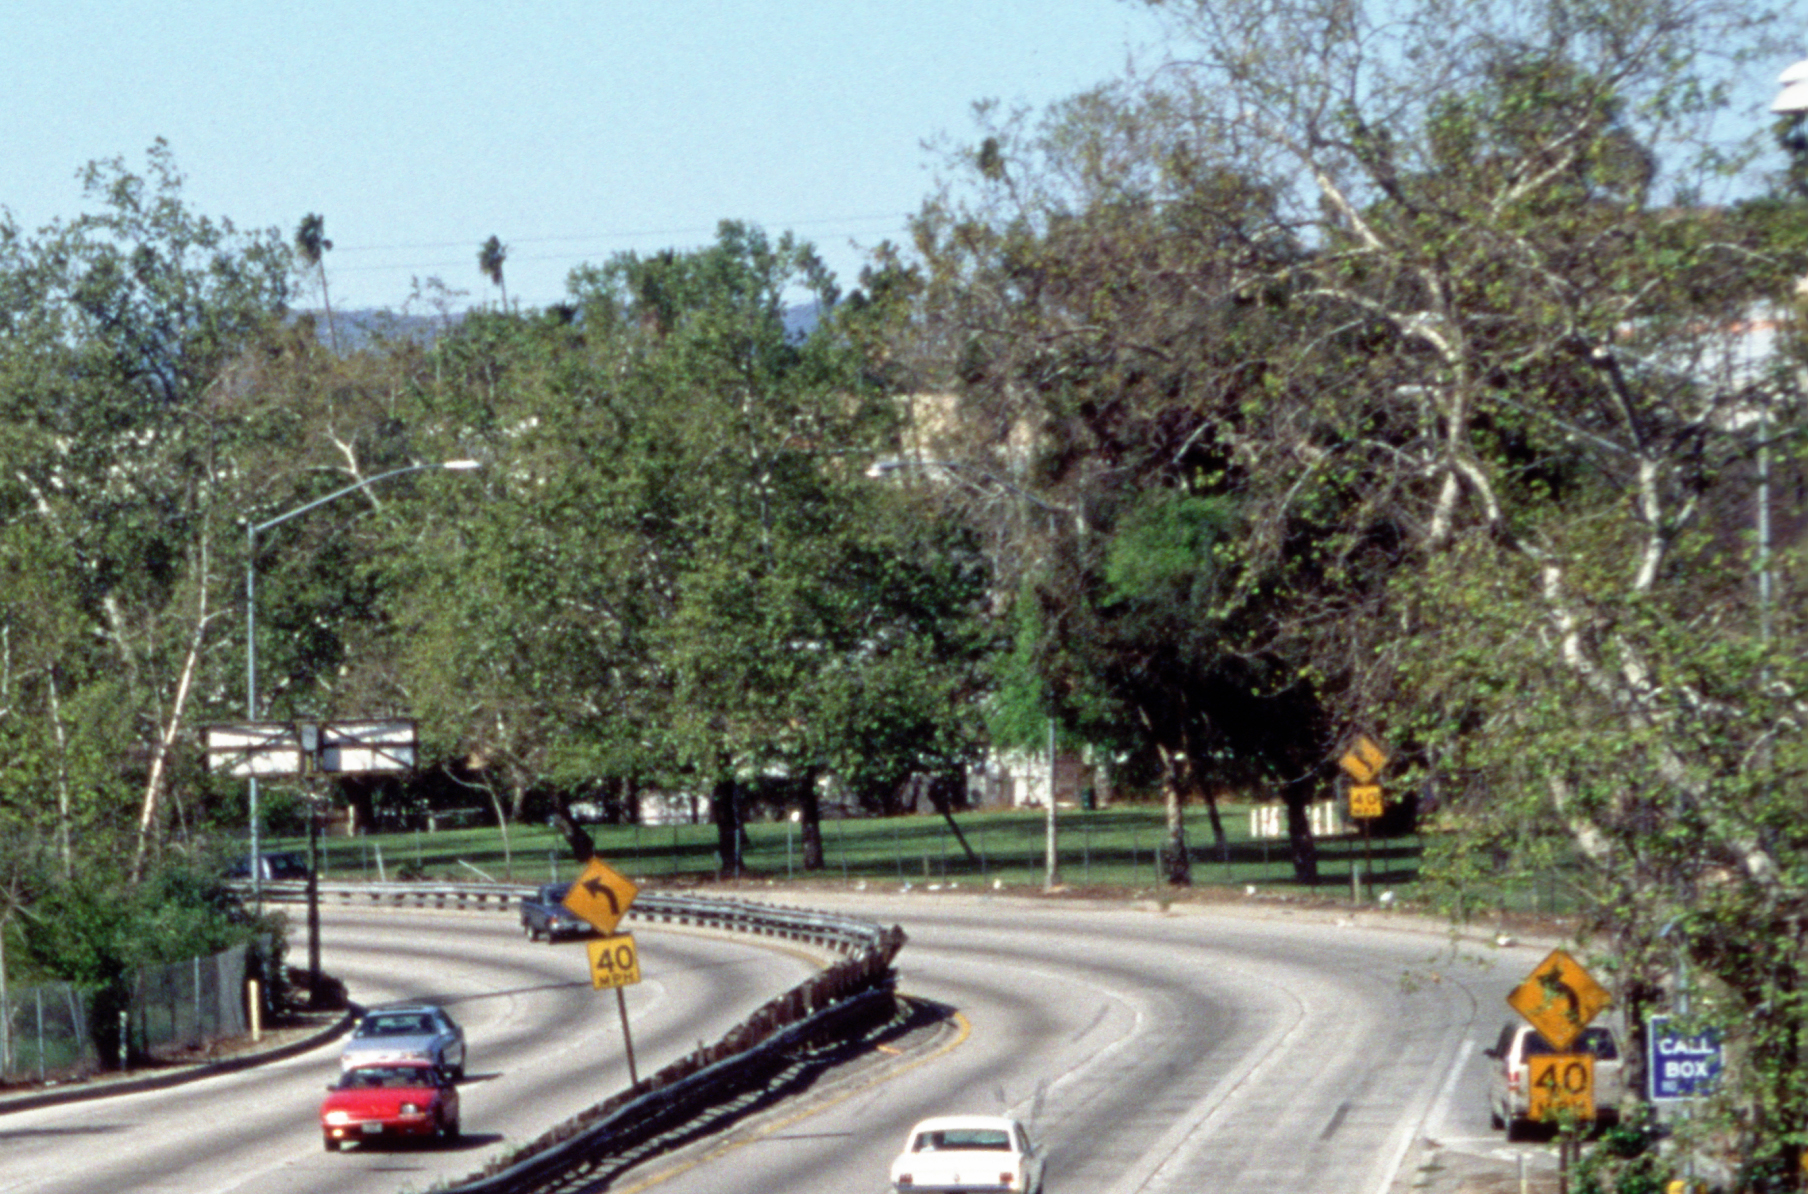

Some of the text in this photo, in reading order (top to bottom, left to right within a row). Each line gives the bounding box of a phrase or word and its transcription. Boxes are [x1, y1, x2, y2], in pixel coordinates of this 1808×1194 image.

[597, 944, 634, 973] 40
[599, 973, 634, 986] MPH
[1659, 1037, 1715, 1055] CALL
[1534, 1062, 1588, 1095] 40
[1664, 1060, 1709, 1079] BOX
